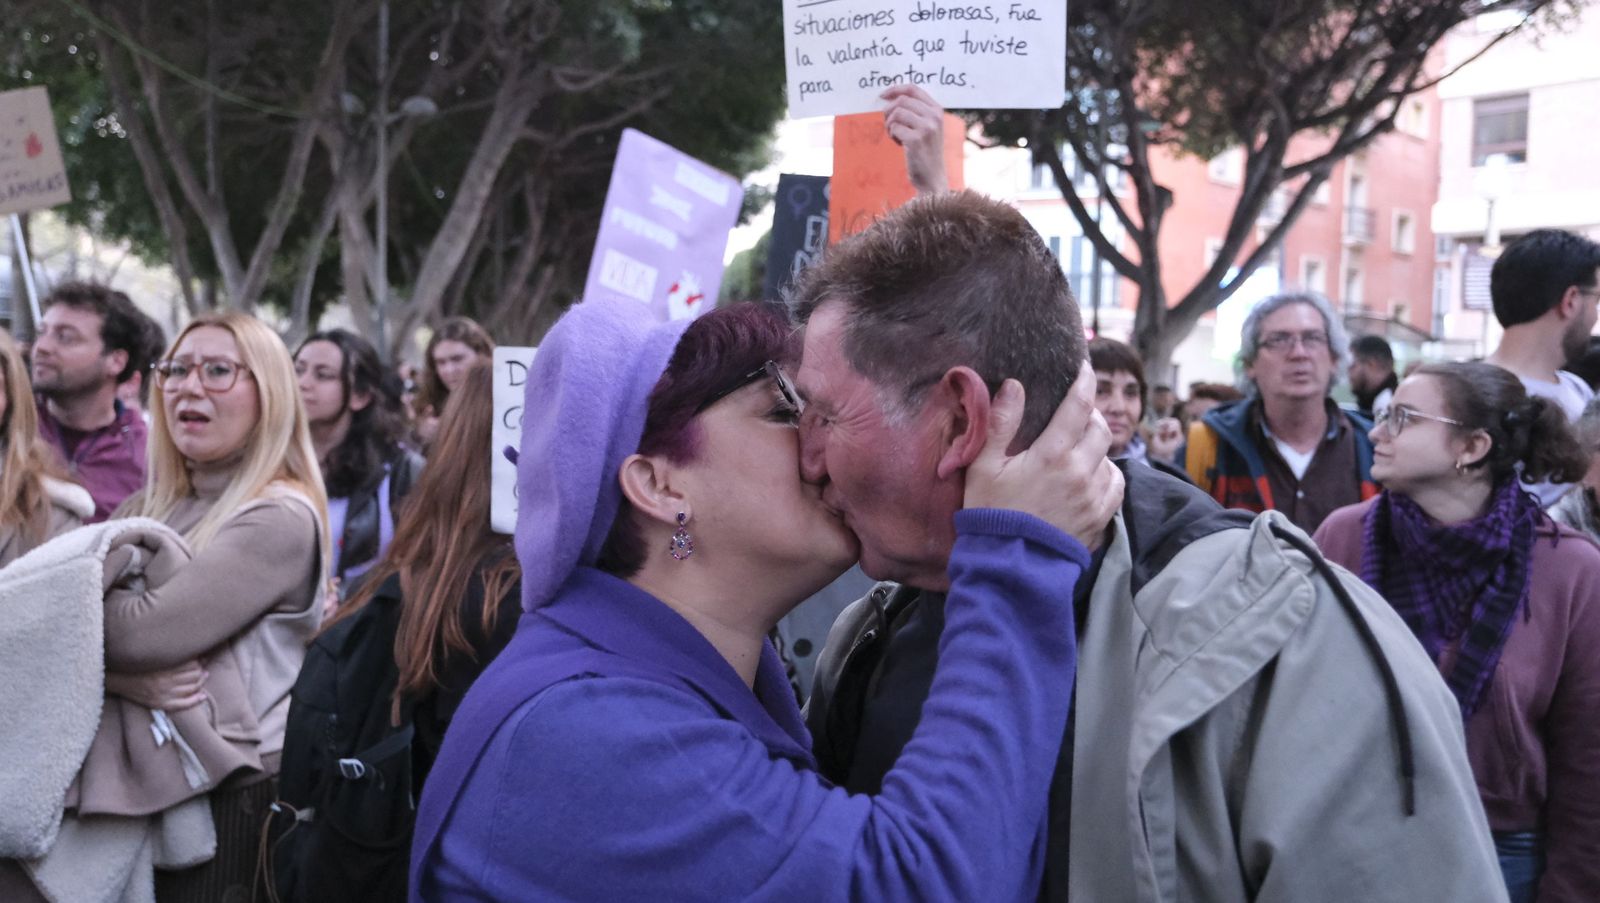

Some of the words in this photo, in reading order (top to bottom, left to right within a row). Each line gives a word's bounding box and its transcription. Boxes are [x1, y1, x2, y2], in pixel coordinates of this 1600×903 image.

[794, 9, 895, 35] situaciones
[909, 1, 1000, 24] dolorosas,
[796, 46, 814, 67] la
[827, 37, 903, 65] valentía
[913, 38, 945, 61] que
[959, 29, 1028, 56] tuviste
[799, 79, 833, 102] para
